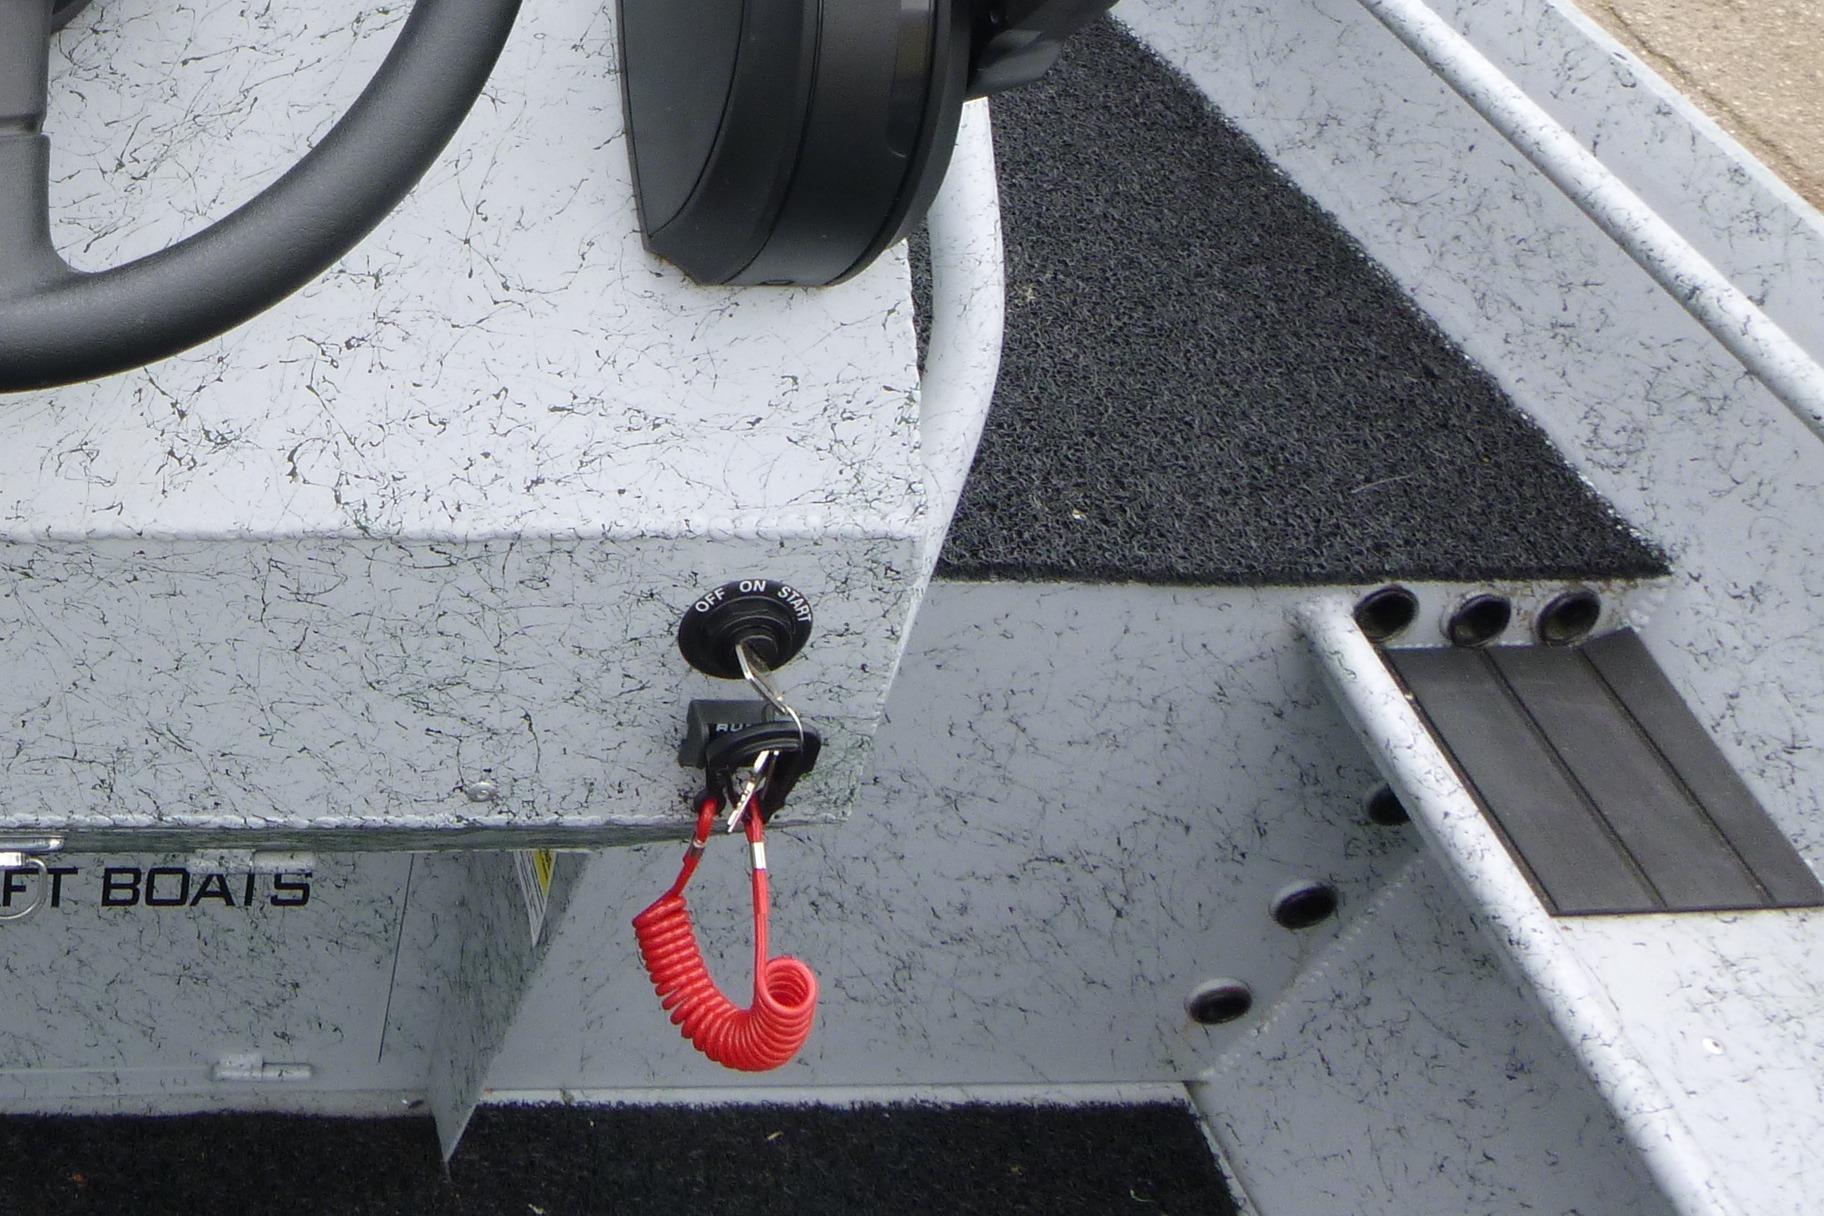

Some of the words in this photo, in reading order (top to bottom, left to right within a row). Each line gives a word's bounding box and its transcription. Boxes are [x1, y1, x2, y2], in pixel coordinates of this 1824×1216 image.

[694, 587, 727, 613] OFF
[738, 579, 767, 593] ON
[777, 586, 813, 624] START
[100, 867, 313, 909] BOATS
